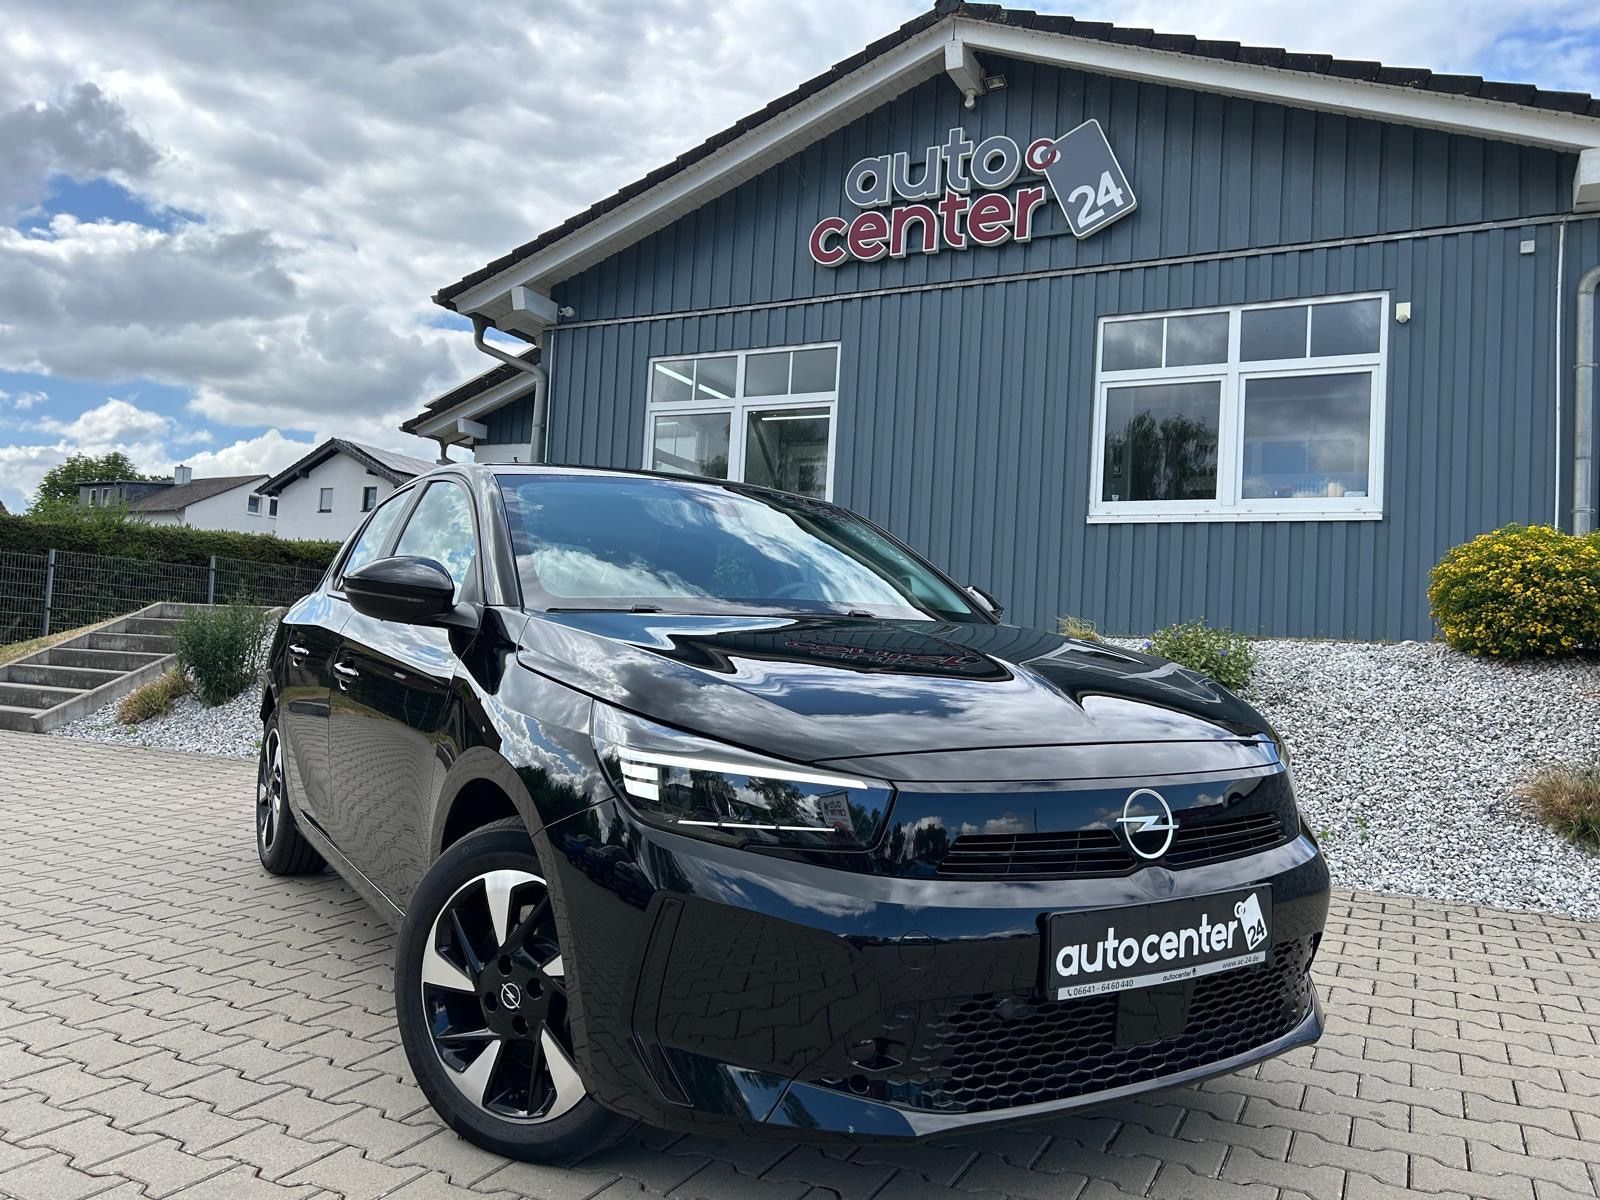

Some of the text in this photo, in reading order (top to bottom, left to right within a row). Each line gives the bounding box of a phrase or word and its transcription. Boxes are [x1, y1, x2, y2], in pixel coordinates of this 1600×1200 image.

[845, 127, 1022, 209] auto
[1068, 170, 1123, 228] 24
[809, 187, 1046, 267] center
[1247, 918, 1265, 946] 24
